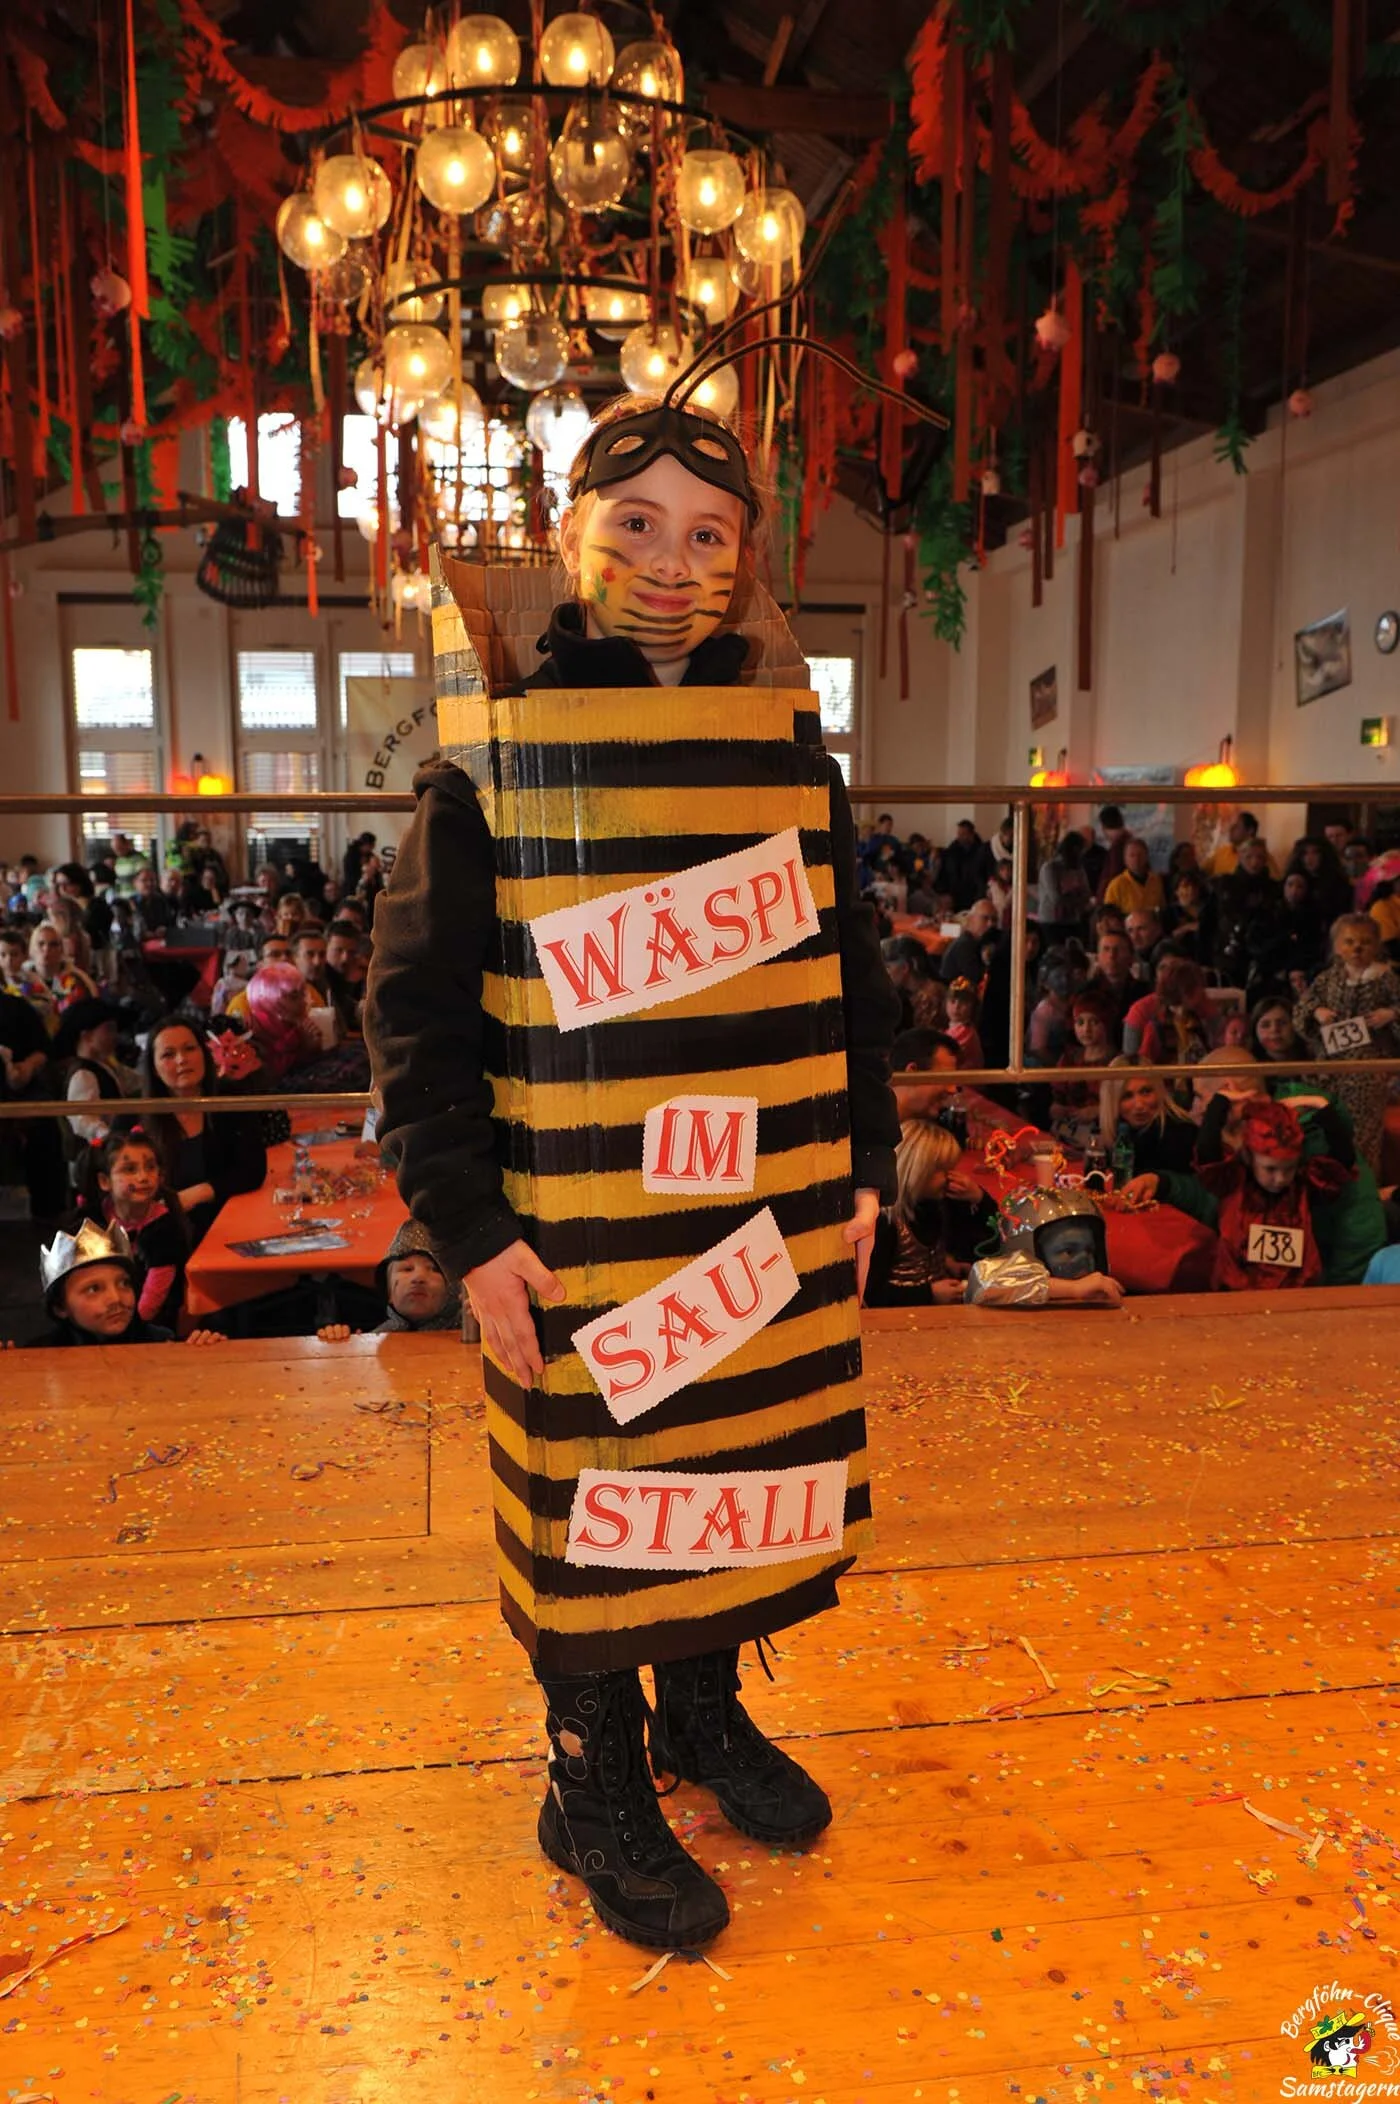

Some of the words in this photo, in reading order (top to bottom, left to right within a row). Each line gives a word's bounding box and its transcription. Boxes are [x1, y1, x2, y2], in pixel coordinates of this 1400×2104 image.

[542, 858, 809, 1010] WÄSPI
[1328, 1022, 1364, 1049] 133
[651, 1107, 748, 1182] IM
[1252, 1229, 1296, 1263] 138
[590, 1244, 784, 1400] SAU-
[574, 1478, 835, 1555] STALL
